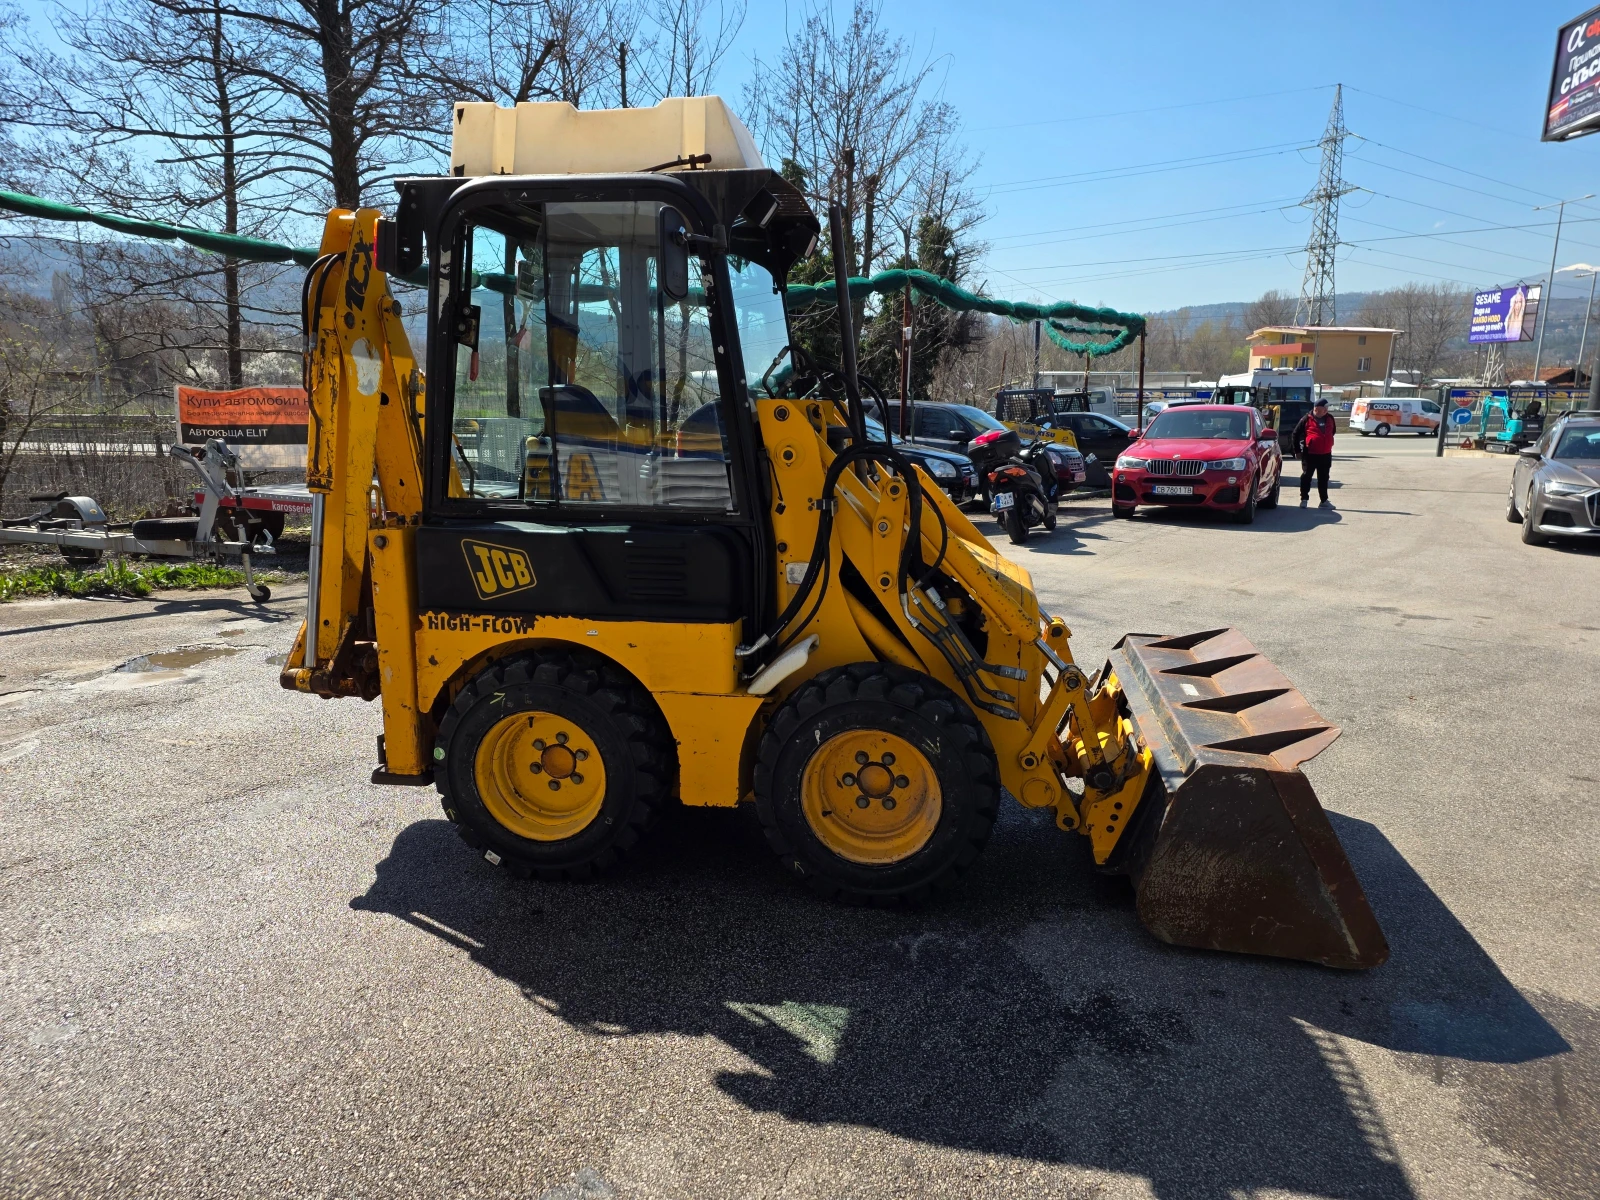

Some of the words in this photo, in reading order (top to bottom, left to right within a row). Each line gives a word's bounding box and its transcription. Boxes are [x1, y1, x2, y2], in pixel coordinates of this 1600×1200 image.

[1476, 292, 1501, 305] SESAME
[187, 396, 220, 408] Купи
[225, 396, 300, 406] автомобил
[189, 428, 244, 438] АВТОКЪЩА
[246, 428, 268, 437] ELIT
[473, 545, 531, 593] JCB
[428, 616, 530, 634] HIGH-FLOW
